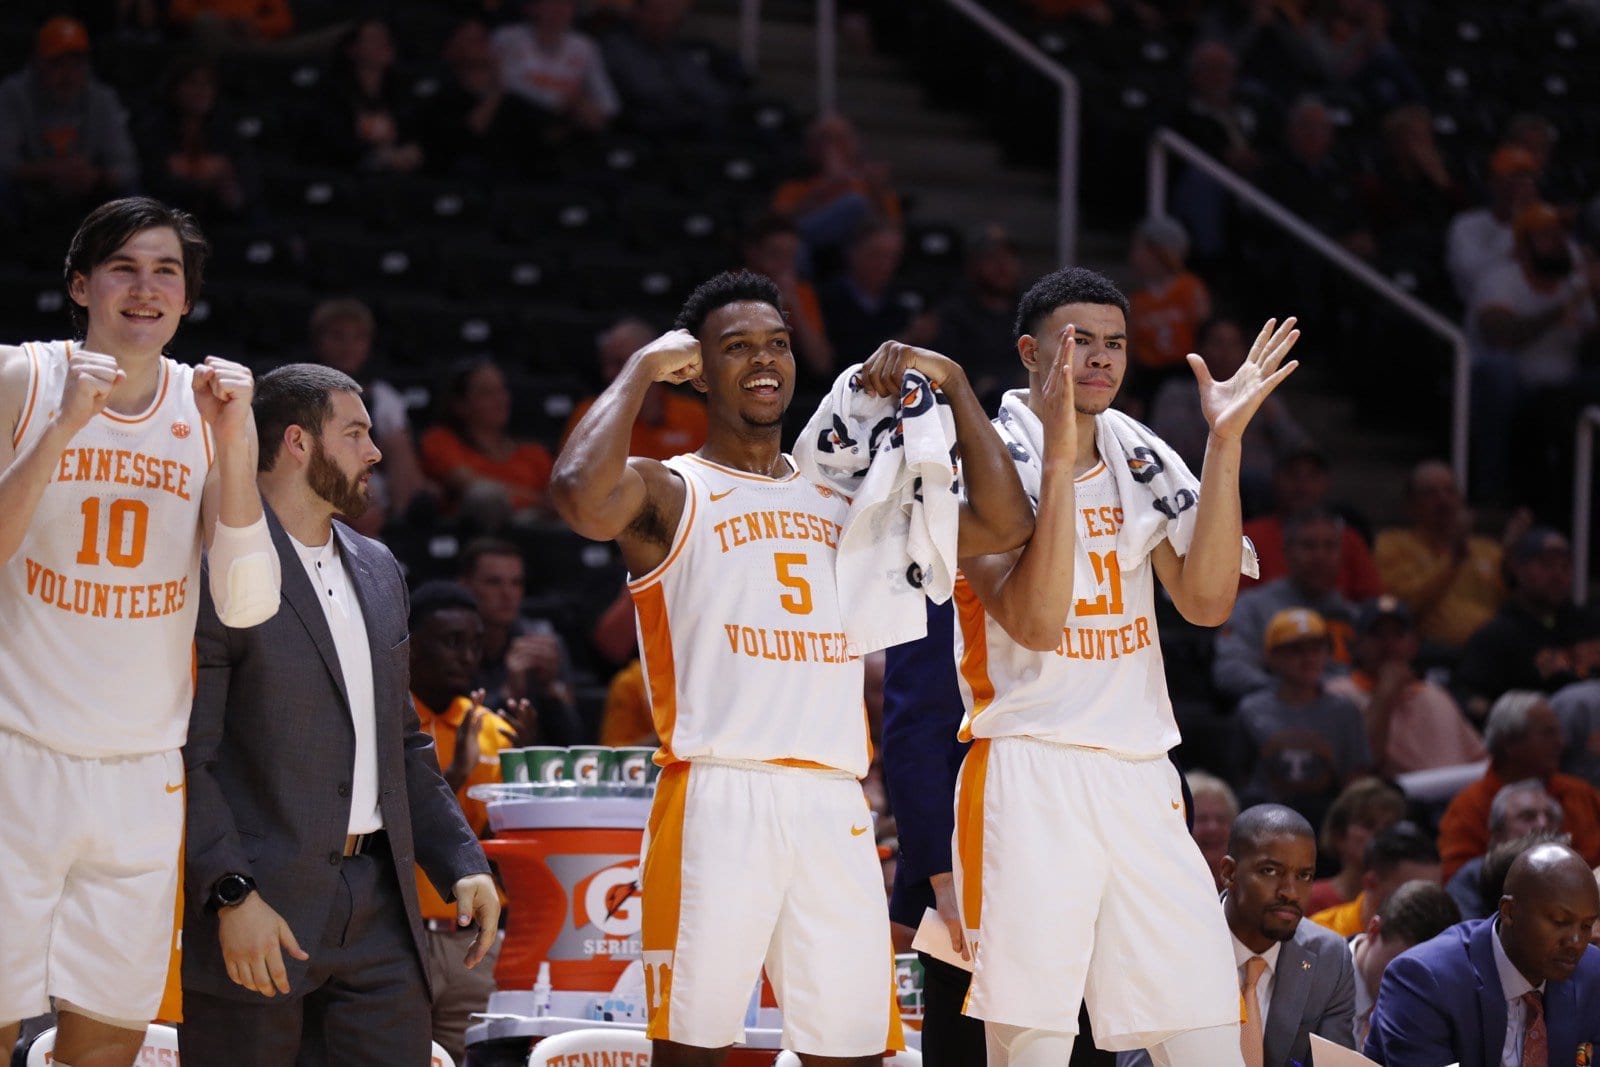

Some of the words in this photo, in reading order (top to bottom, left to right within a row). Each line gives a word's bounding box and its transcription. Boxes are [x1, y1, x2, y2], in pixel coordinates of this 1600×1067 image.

[49, 448, 192, 501] ENNESSEE
[77, 496, 149, 568] 10
[26, 558, 189, 619] VOLUNTEERS
[774, 553, 813, 615] 5
[724, 624, 860, 663] VOLUNTEER
[574, 756, 599, 786] G
[622, 757, 646, 787] G
[583, 939, 640, 954] SERIE
